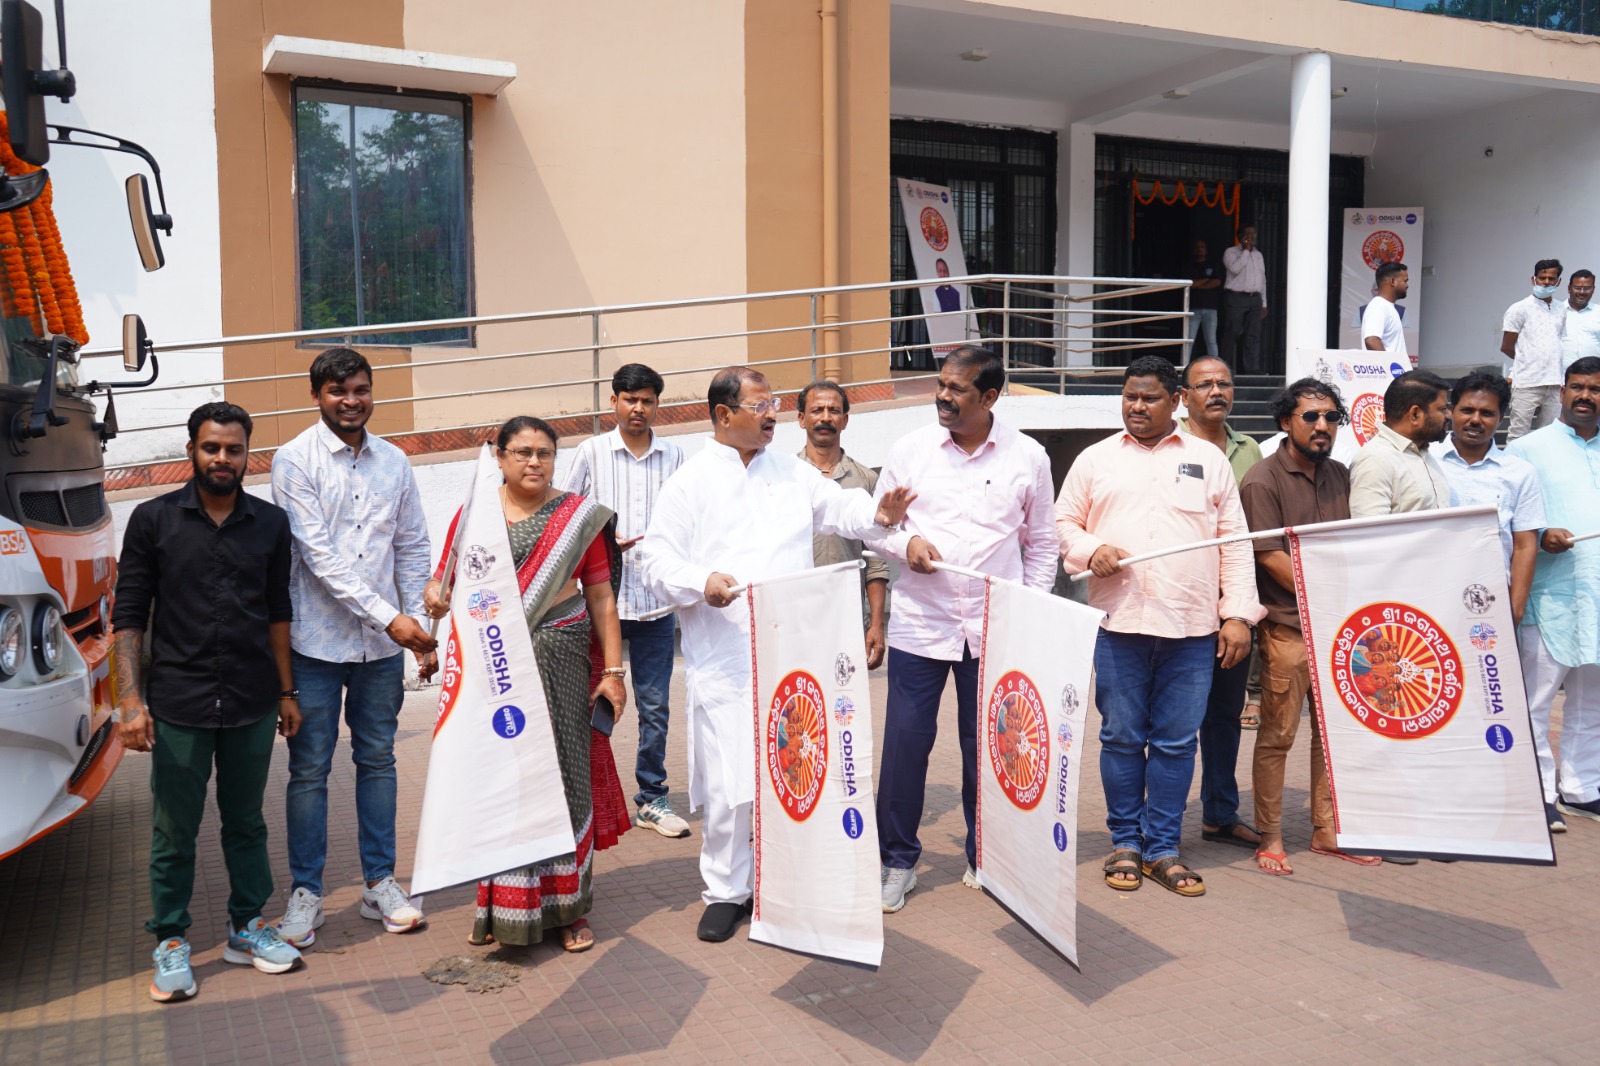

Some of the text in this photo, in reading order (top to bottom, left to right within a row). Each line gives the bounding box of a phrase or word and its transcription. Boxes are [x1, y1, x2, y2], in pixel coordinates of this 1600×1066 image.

[1353, 364, 1386, 374] ODISHA
[486, 624, 512, 695] ODISHA
[1382, 608, 1400, 623] ଶ୍ରୀ
[1404, 612, 1450, 656] ଜଗନ୍ନାଥ
[1444, 660, 1462, 698] ଦର୍ଶନ
[1336, 669, 1369, 722] ସରକାର
[1485, 654, 1504, 714] ODISHA
[503, 708, 517, 735] OSRTC
[842, 730, 857, 797] ODISHA
[1059, 755, 1068, 813] ODISHA
